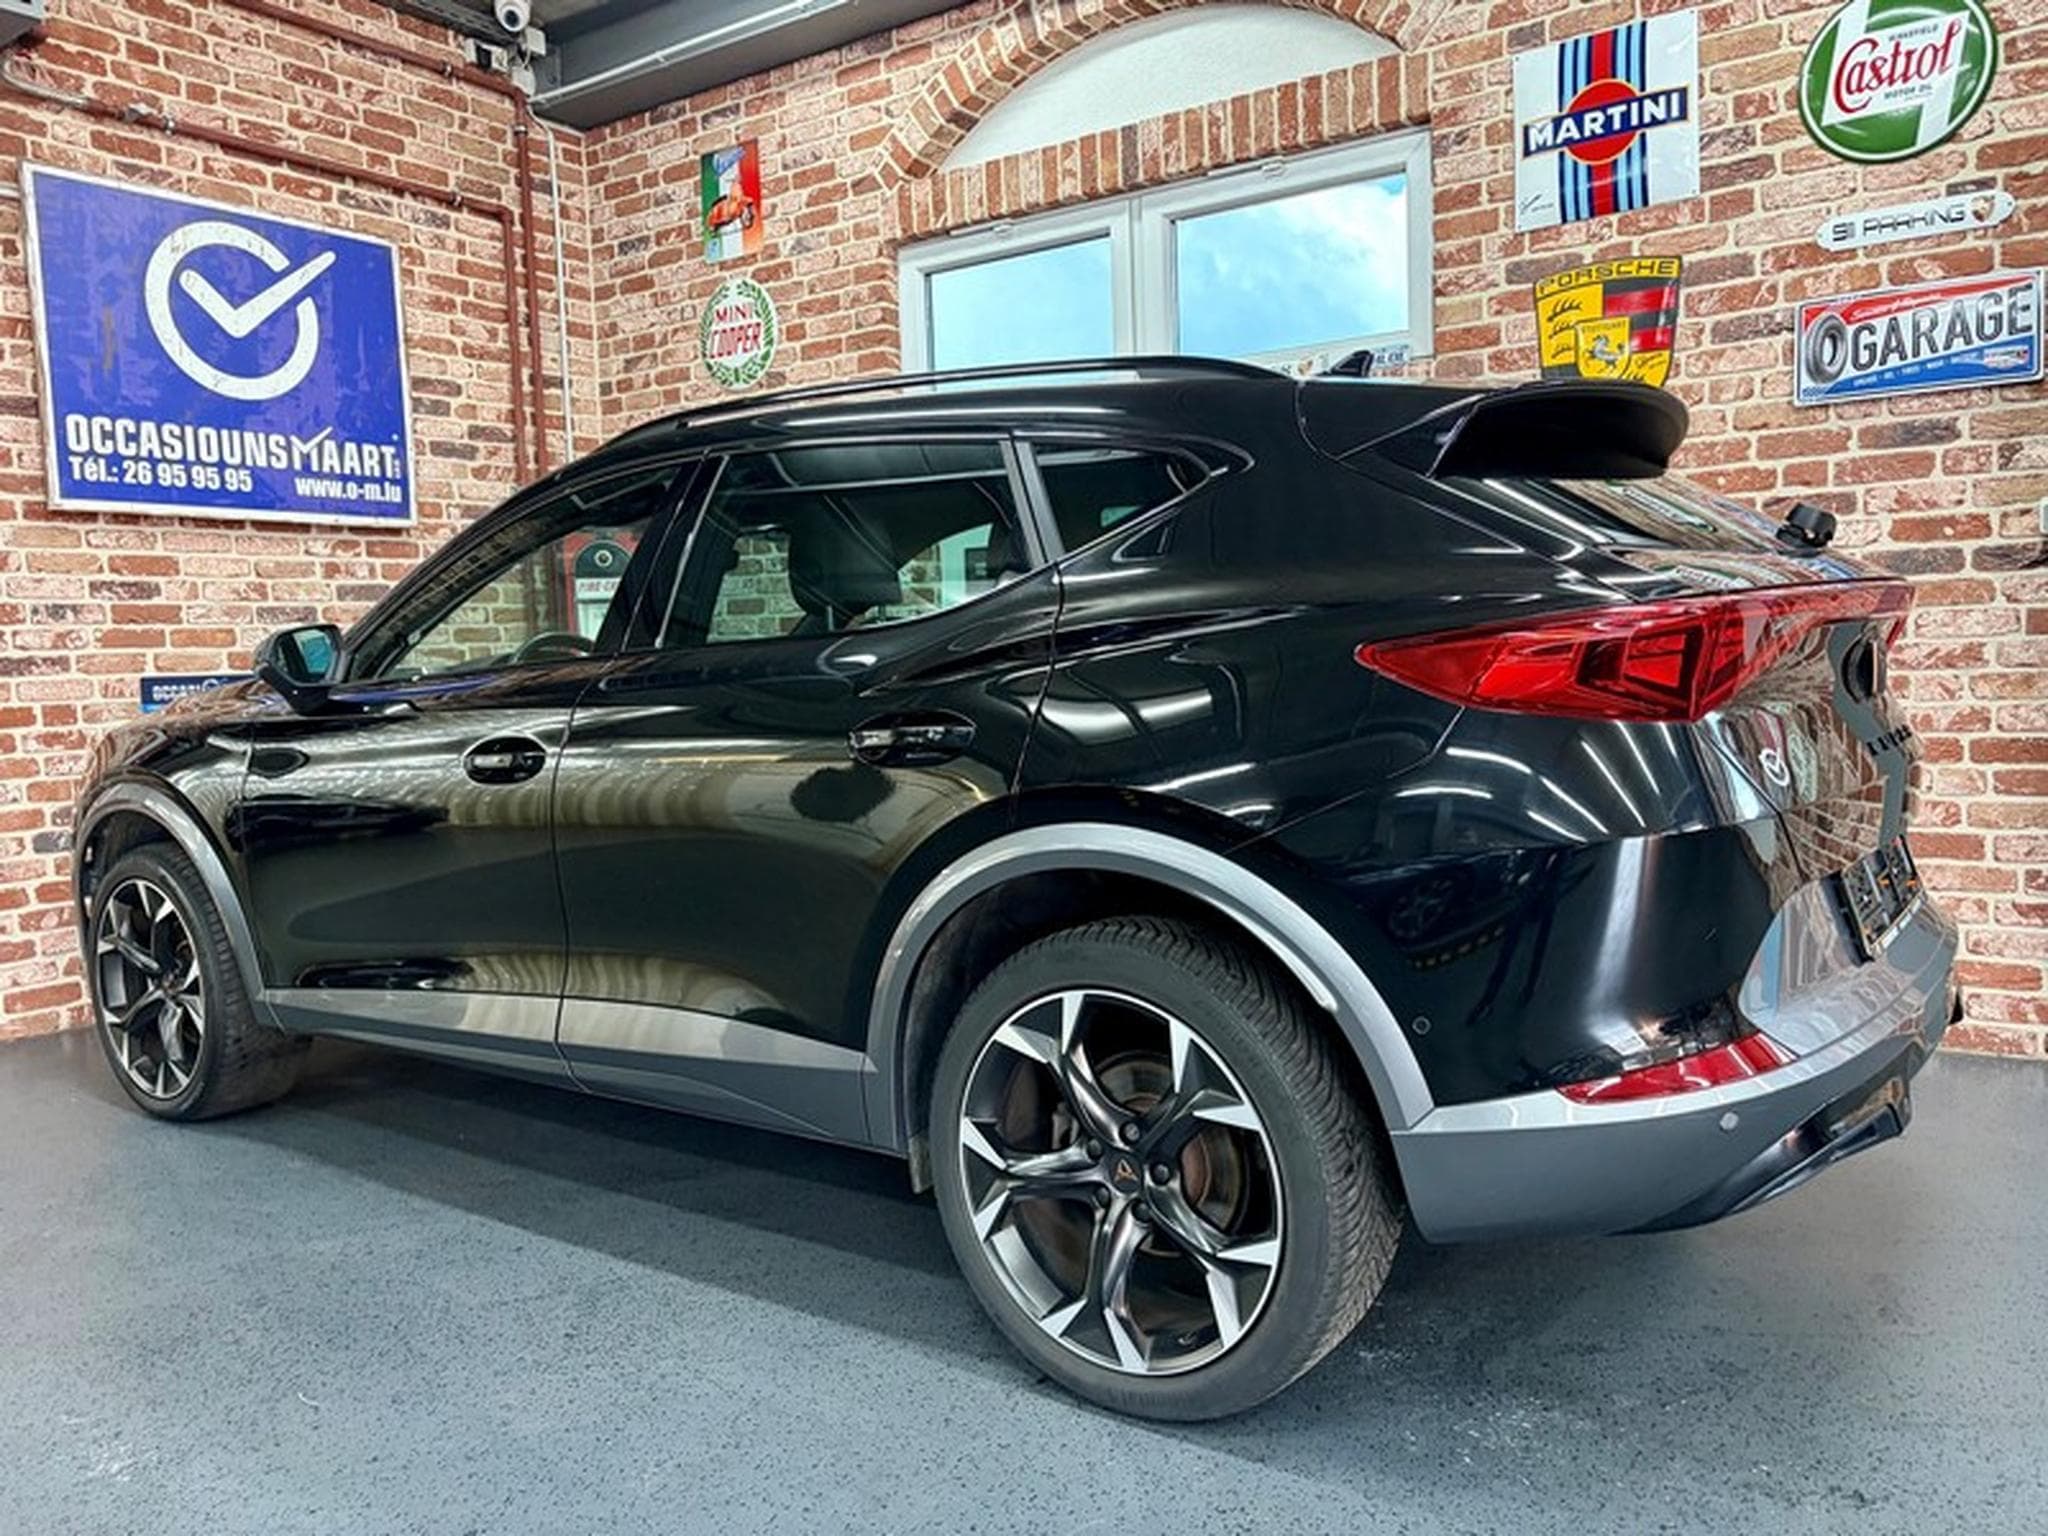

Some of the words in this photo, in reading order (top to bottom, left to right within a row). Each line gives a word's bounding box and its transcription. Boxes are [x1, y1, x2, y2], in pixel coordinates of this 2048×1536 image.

[1833, 18, 1962, 114] Castrol
[1528, 92, 1680, 151] MARTINI
[1863, 203, 1965, 237] PARKING
[1538, 259, 1675, 295] PORSCHE
[715, 303, 753, 324] MINI
[1851, 282, 2034, 372] GARAGE
[709, 322, 762, 359] COOPER
[68, 456, 119, 482] Tél.:
[122, 459, 152, 485] 26
[157, 462, 187, 488] 95
[191, 466, 221, 491] 95
[225, 469, 252, 493] 95
[295, 476, 402, 503] www.o-m.lu
